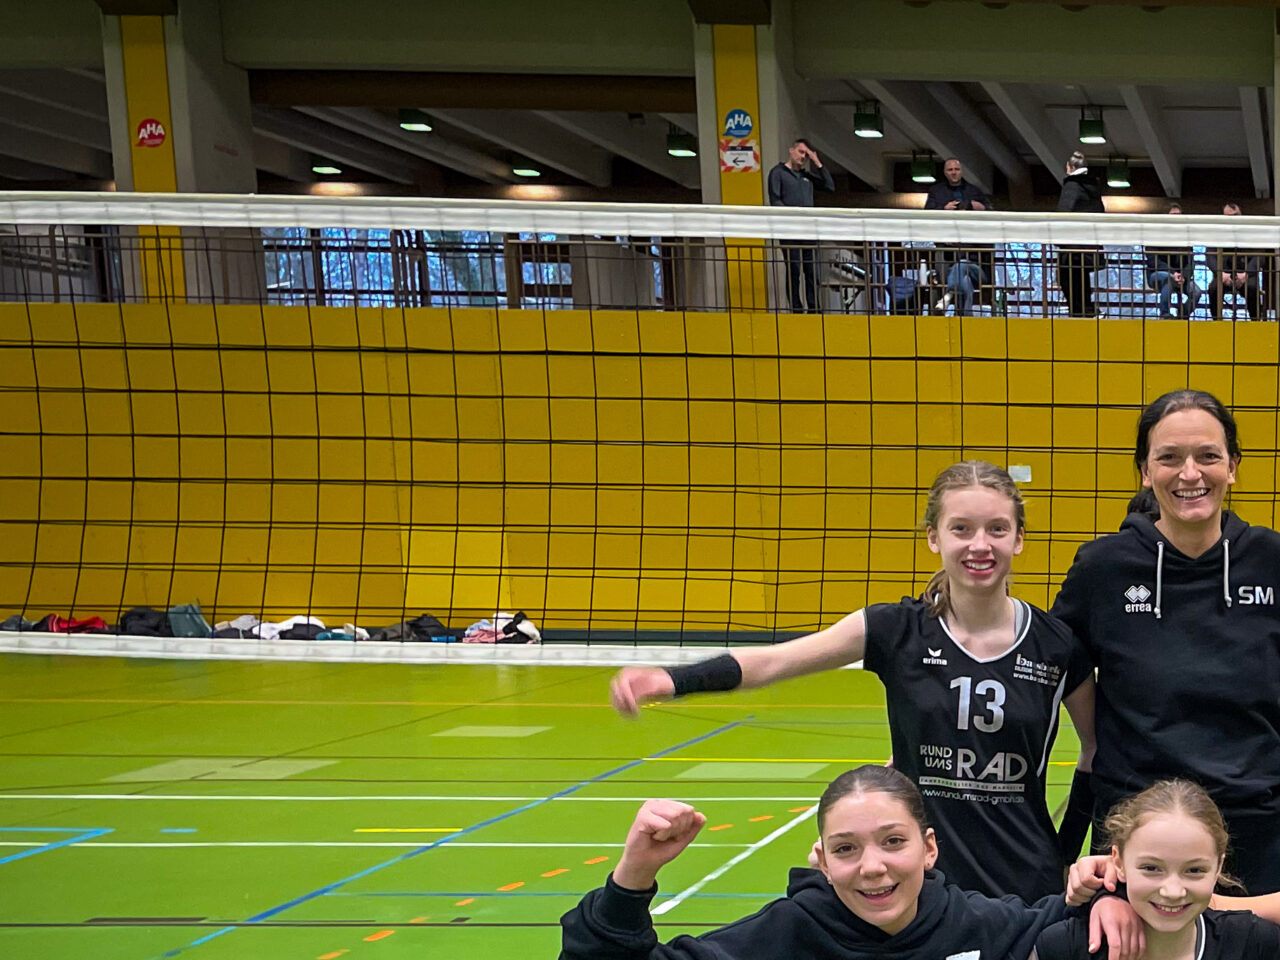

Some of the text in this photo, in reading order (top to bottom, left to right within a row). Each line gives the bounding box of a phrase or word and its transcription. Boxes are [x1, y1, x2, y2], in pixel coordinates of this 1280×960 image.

[725, 113, 752, 130] AHA
[139, 123, 165, 139] AHA
[1238, 586, 1274, 605] SM
[1125, 602, 1152, 613] errea
[923, 657, 948, 666] erima
[950, 676, 1006, 733] 13
[920, 744, 953, 758] RUND
[925, 756, 953, 771] UMS
[956, 748, 1028, 782] RAD
